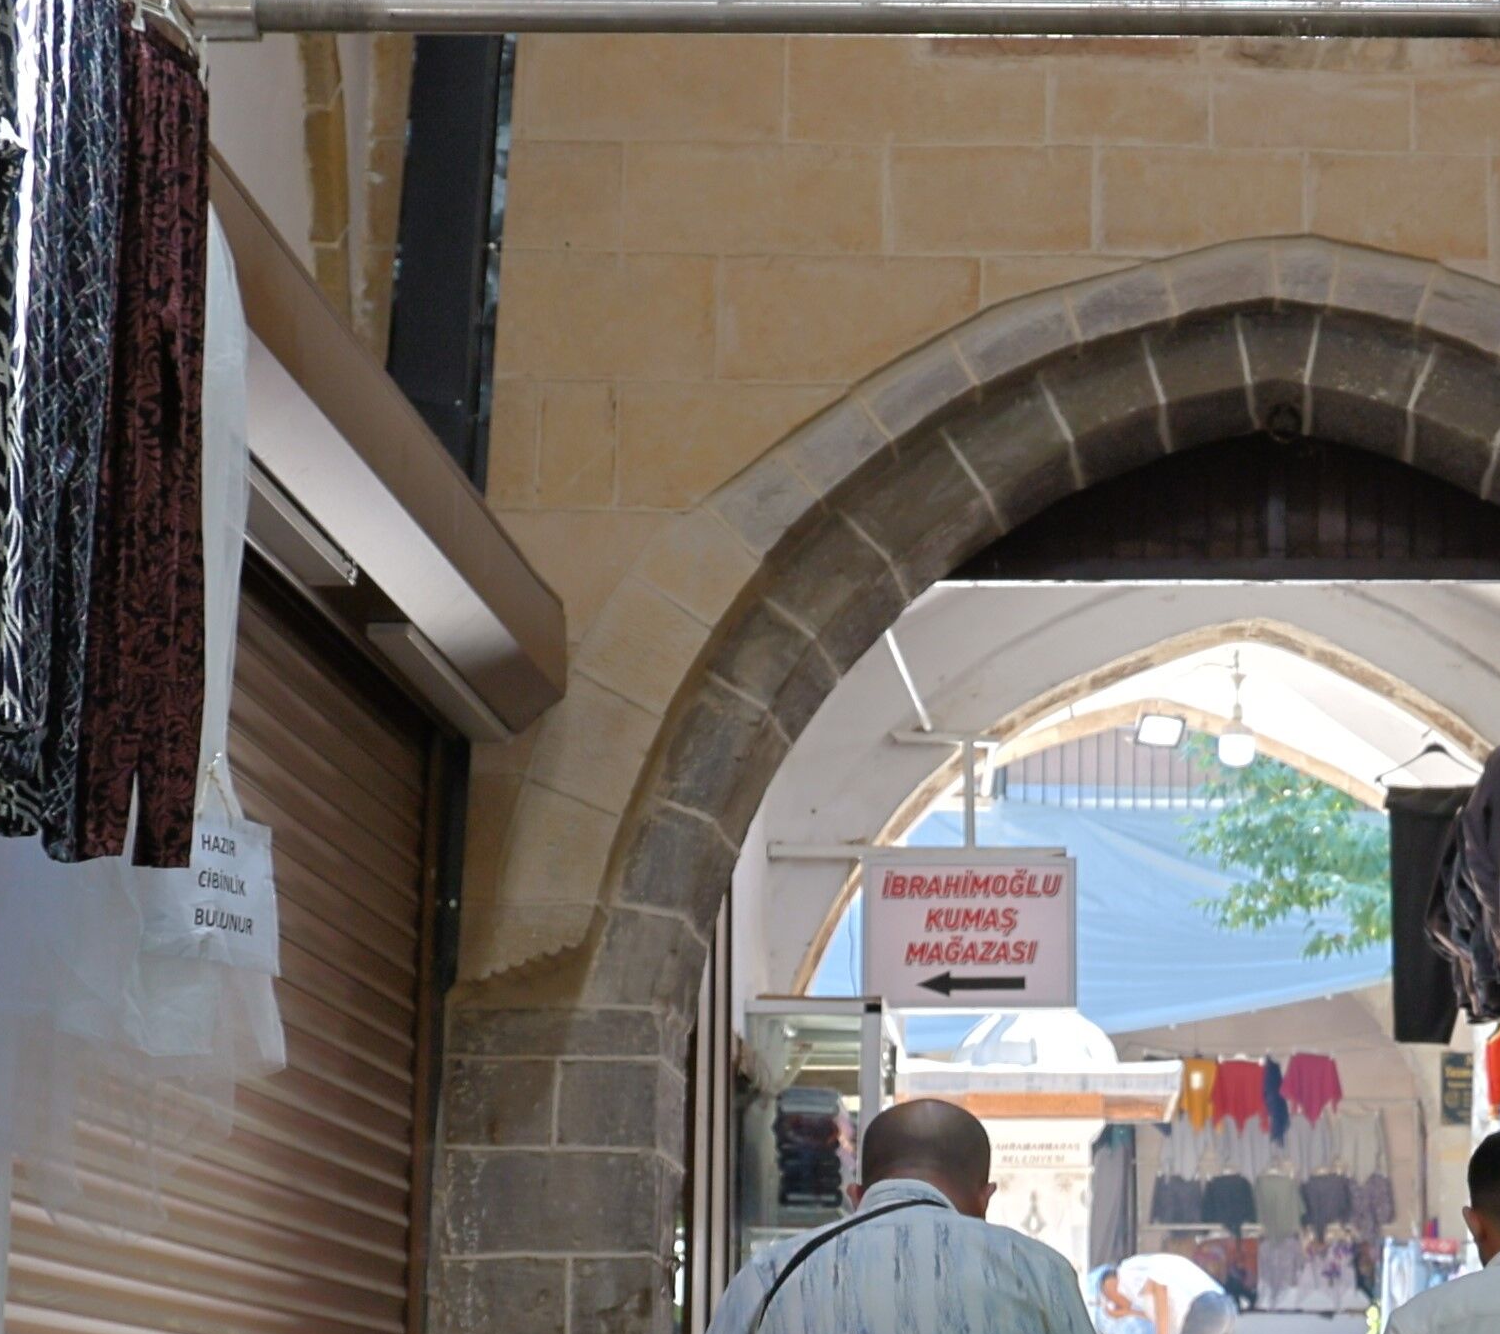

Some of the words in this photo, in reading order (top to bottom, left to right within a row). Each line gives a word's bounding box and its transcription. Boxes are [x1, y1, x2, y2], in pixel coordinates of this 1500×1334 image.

[201, 834, 236, 857] HAZIR
[198, 868, 246, 896] CİBİNLİK
[881, 868, 1063, 899] İBRAHİMOĞLU
[194, 908, 253, 935] BULUNUR
[925, 907, 1019, 936] KUMAŞ
[904, 936, 1039, 966] MAĞAZASI
